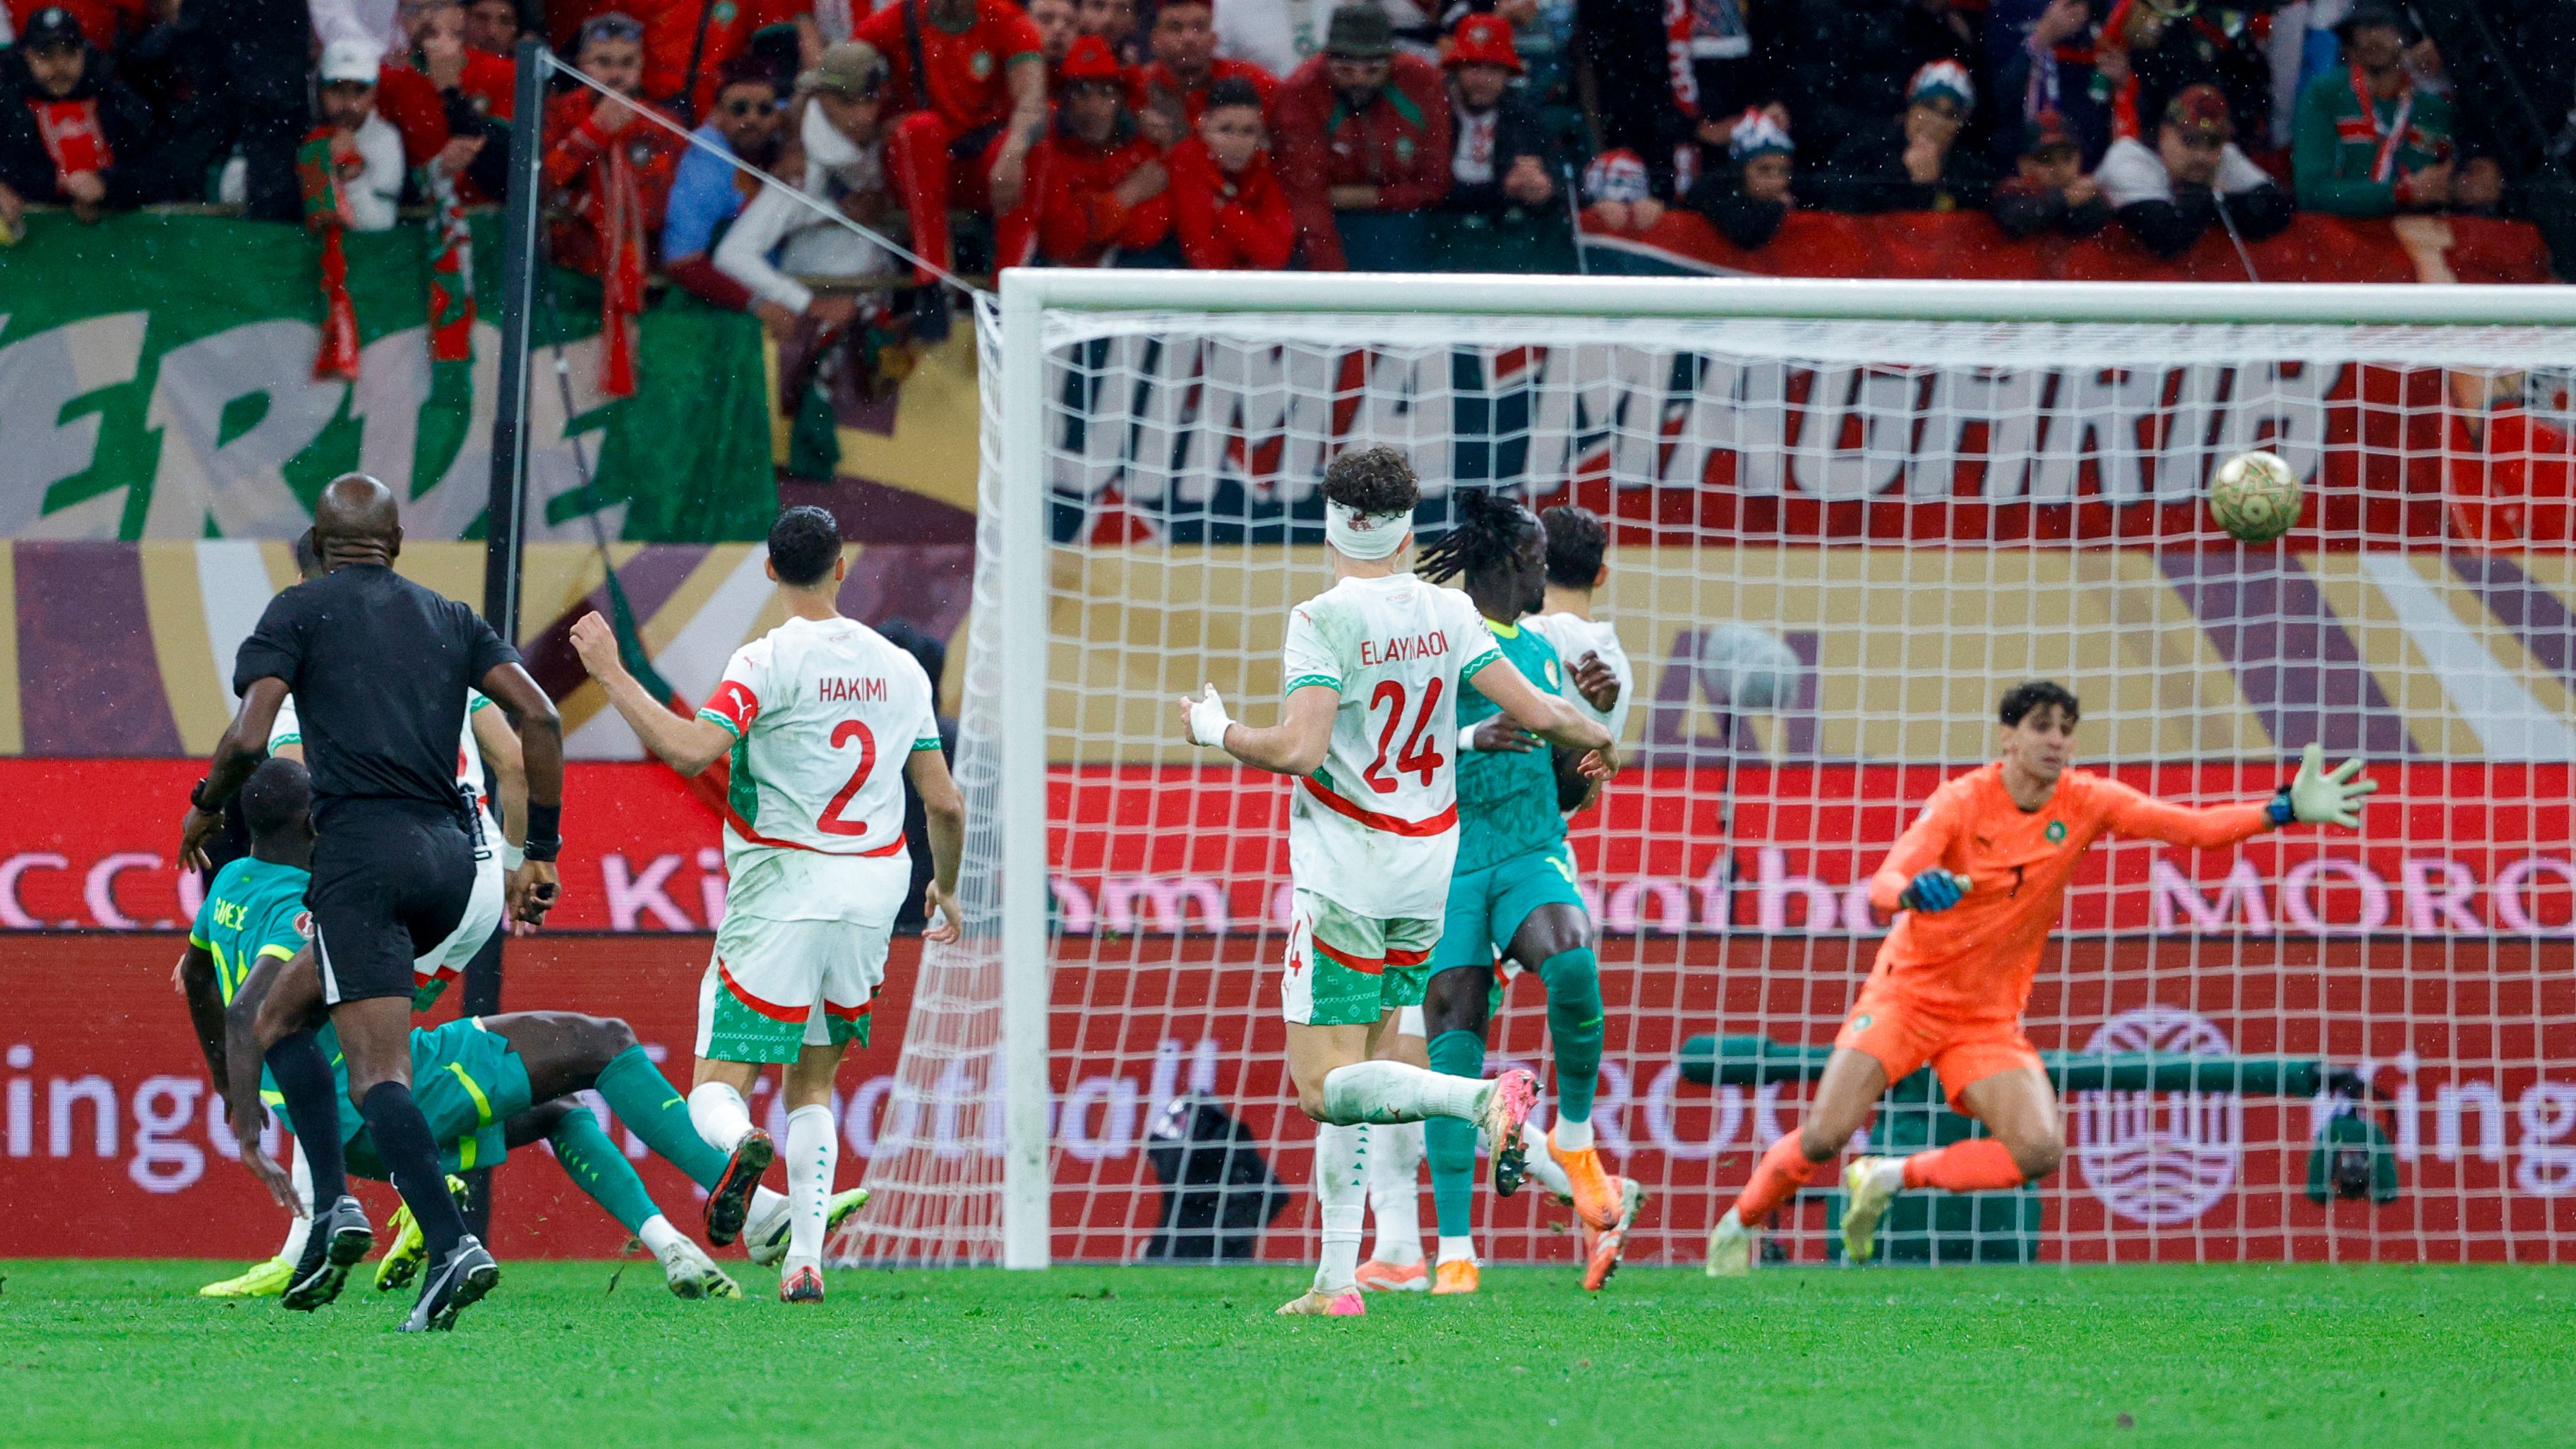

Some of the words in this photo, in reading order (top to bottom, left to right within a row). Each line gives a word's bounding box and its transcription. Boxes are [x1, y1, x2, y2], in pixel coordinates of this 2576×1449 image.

[0, 311, 641, 542] ERDE
[819, 676, 887, 703] HAKIMI
[1362, 676, 1444, 794] 24
[817, 719, 876, 836] 2
